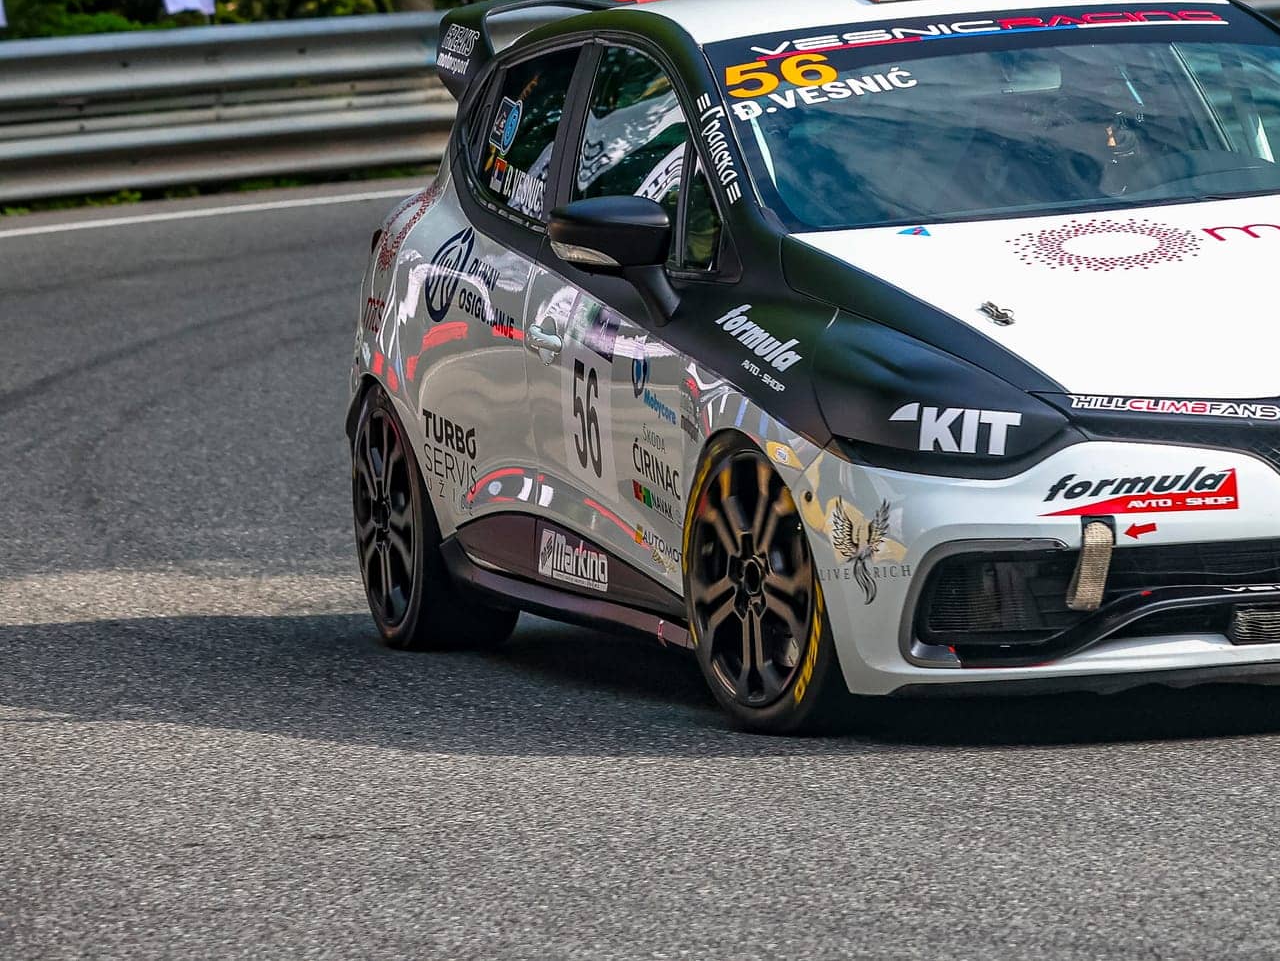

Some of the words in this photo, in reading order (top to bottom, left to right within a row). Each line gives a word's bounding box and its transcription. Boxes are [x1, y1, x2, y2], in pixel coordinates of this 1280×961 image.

[725, 52, 839, 99] 56
[714, 304, 802, 373] formula
[573, 359, 603, 479] 56
[918, 405, 1023, 456] KIT
[423, 443, 478, 495] SERVIS
[1043, 466, 1229, 503] formula
[1185, 496, 1235, 507] SHOP
